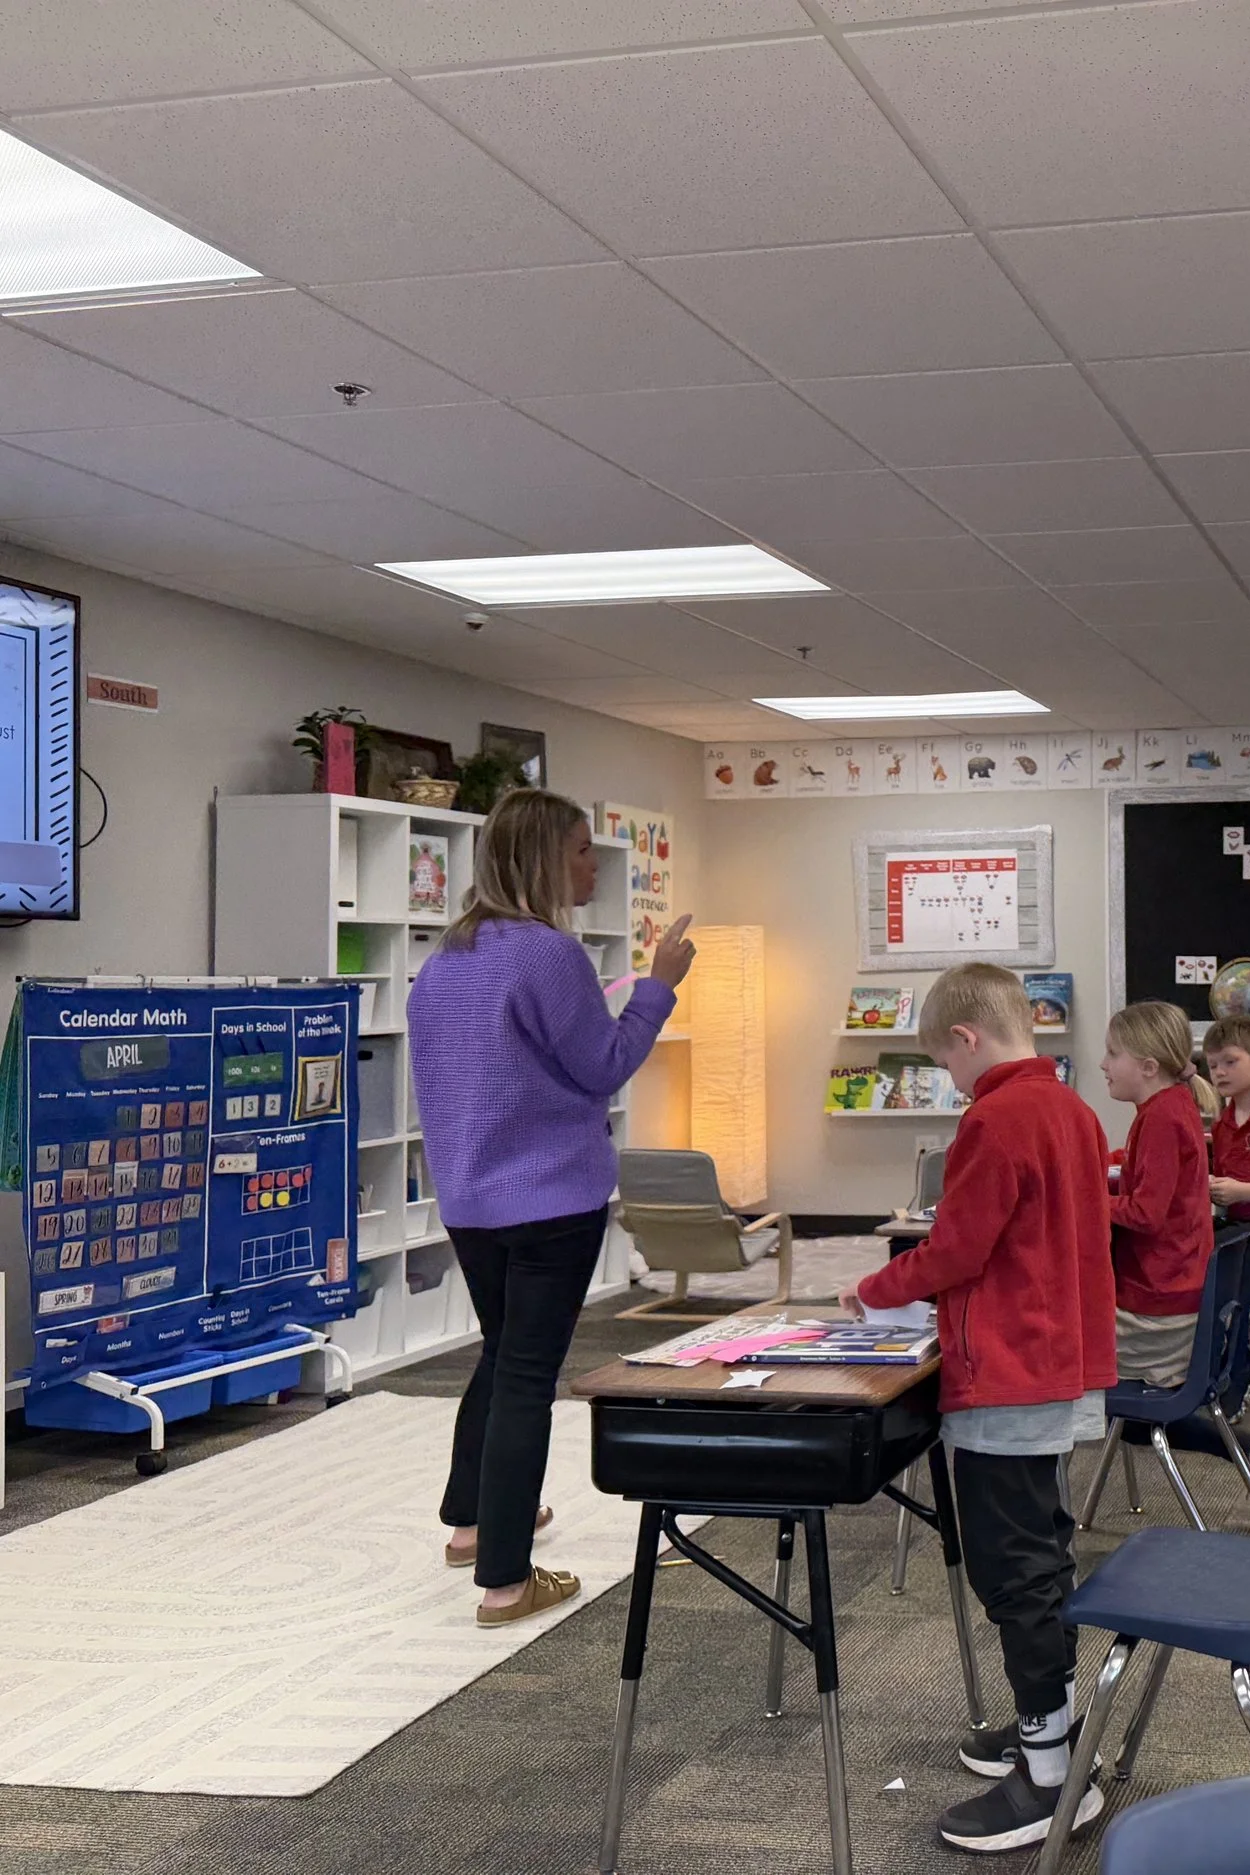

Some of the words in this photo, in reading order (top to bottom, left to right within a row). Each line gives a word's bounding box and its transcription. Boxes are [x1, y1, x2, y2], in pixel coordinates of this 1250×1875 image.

[100, 681, 148, 705] South
[1009, 740, 1027, 750] Hh
[1097, 738, 1108, 749] Jj
[1143, 736, 1159, 747] Kk
[1186, 735, 1198, 745] Ll
[793, 747, 808, 758] Cc
[835, 746, 853, 757] Dd
[878, 744, 893, 755] Ee
[965, 741, 983, 753] Gg
[751, 748, 765, 759] Bb
[632, 858, 670, 895] ader
[59, 1009, 138, 1028] Calendar
[143, 1008, 187, 1026] Math
[221, 1023, 244, 1036] Days
[246, 1022, 254, 1032] in
[256, 1022, 287, 1033] School
[307, 1026, 321, 1037] the
[106, 1043, 142, 1069] APRIL
[247, 1101, 254, 1112] 3
[269, 1099, 276, 1111] 2
[149, 1110, 157, 1125] 2
[257, 1132, 306, 1147] en-Frames
[47, 1147, 56, 1165] 5
[167, 1132, 180, 1150] 10
[218, 1159, 226, 1169] 6
[38, 1182, 53, 1203] 12
[70, 1180, 83, 1196] 13
[93, 1177, 108, 1197] 14
[43, 1216, 58, 1236] 19
[64, 1214, 85, 1234] 20
[117, 1206, 135, 1226] 22
[62, 1245, 81, 1265] 27
[91, 1241, 107, 1261] 28
[54, 1292, 77, 1306] SPRING
[198, 1314, 225, 1326] Counting
[230, 1310, 244, 1319] Days
[203, 1323, 222, 1333] Sticks
[158, 1329, 185, 1341] Numbers
[106, 1340, 132, 1352] Months
[61, 1355, 77, 1365] Days
